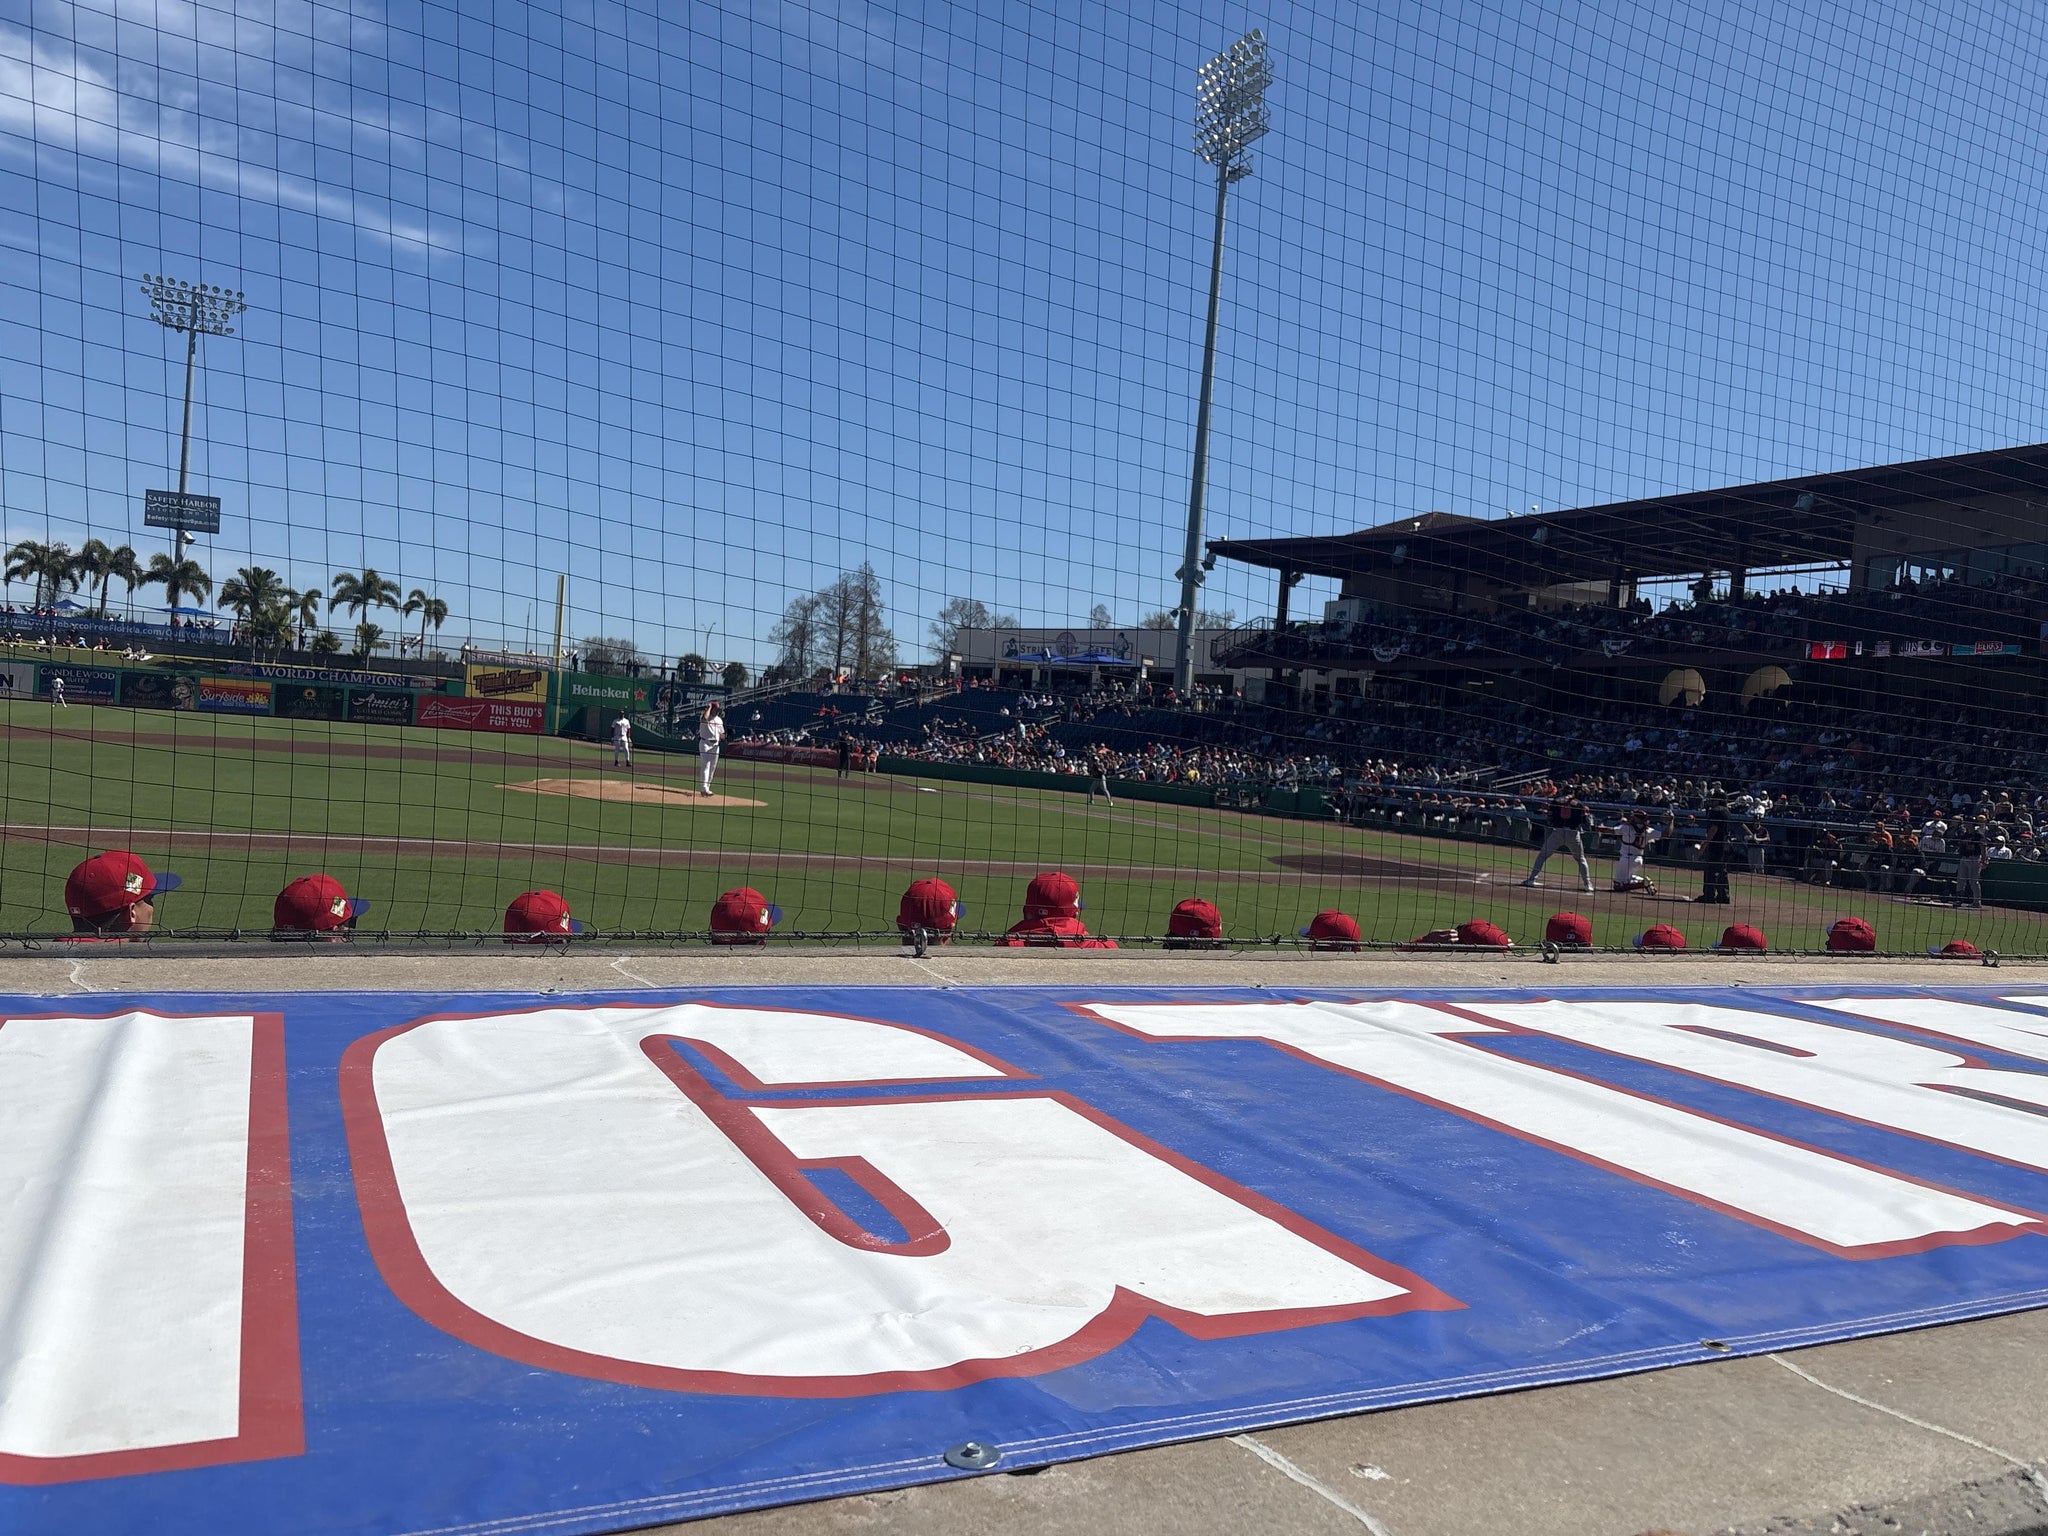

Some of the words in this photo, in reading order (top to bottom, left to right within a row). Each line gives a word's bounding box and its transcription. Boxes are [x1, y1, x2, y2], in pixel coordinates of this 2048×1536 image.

[147, 494, 179, 505] SAFETY
[181, 498, 218, 510] HARBOR
[40, 667, 115, 680] CANDLEWOOD
[261, 666, 316, 680] WORLD
[319, 670, 406, 687] CHAMPIONS
[199, 688, 245, 703] Surfside
[572, 684, 629, 699] Heineken
[489, 704, 512, 716] THIS
[513, 706, 543, 717] BUD'S
[489, 716, 508, 727] FOR
